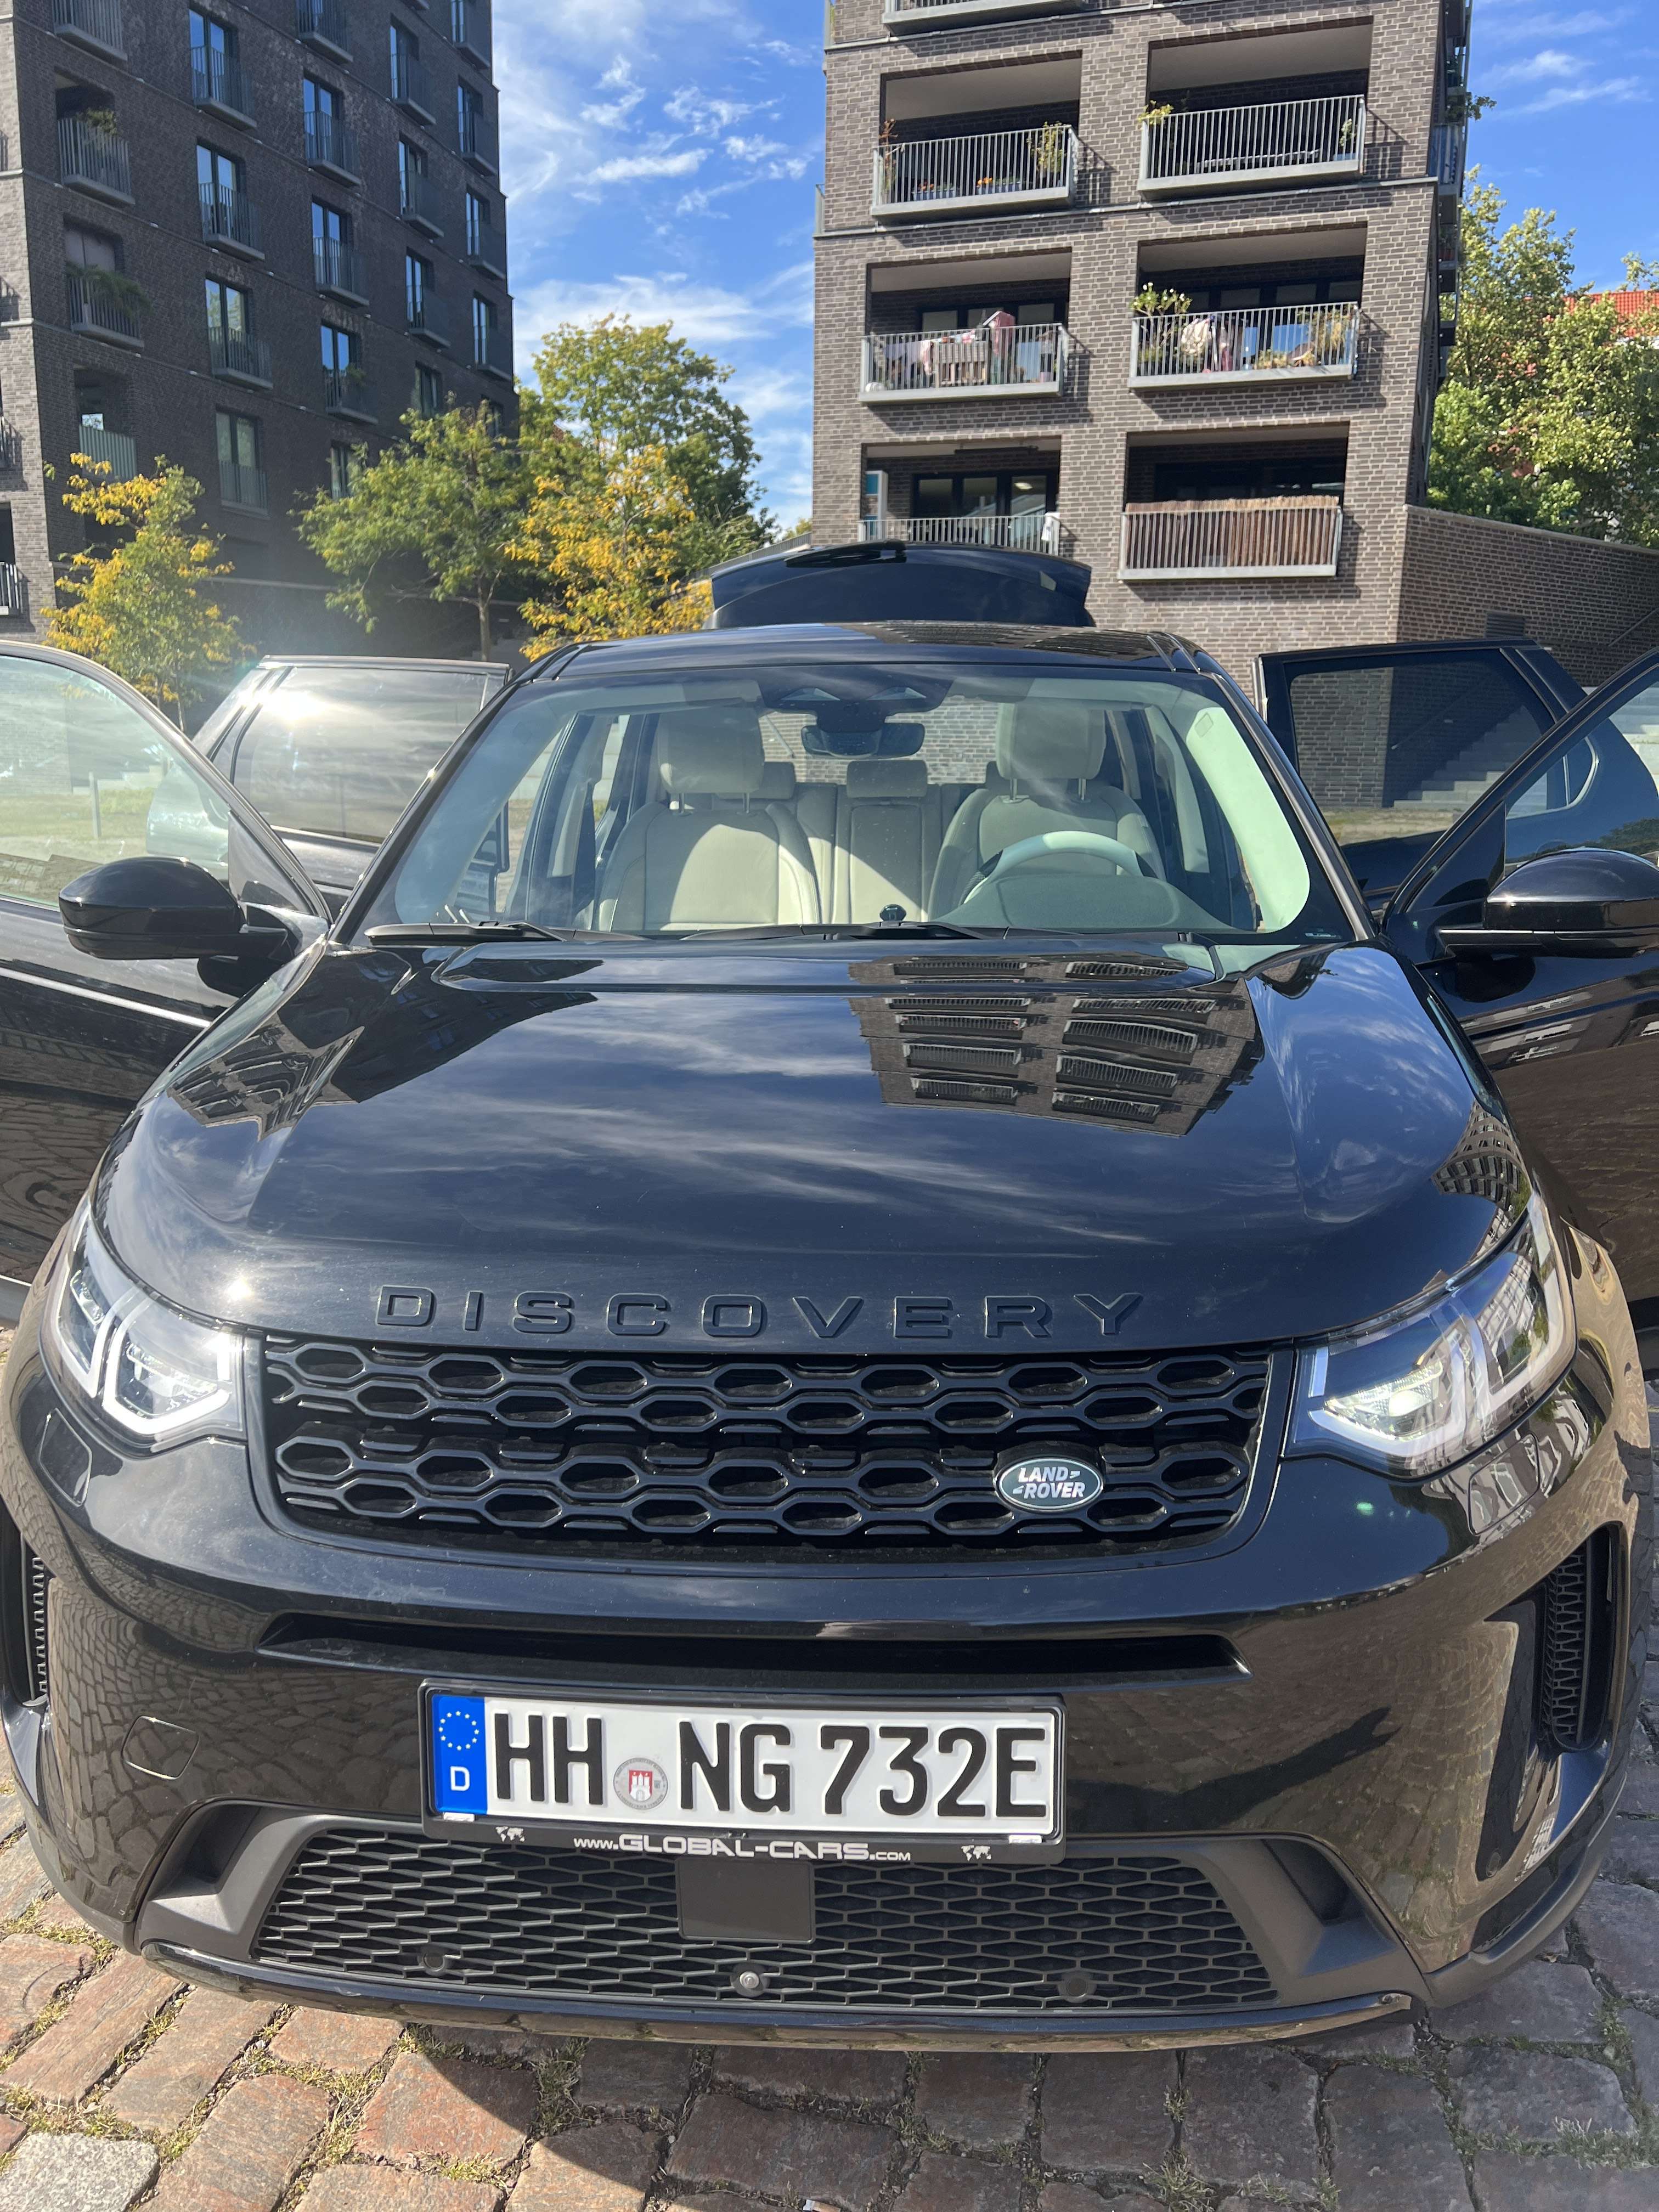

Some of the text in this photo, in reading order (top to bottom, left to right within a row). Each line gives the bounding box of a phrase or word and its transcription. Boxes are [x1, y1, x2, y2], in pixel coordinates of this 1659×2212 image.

[376, 1285, 1143, 1338] DISCOVERY
[1018, 1466, 1069, 1482] LAND
[1023, 1482, 1086, 1499] ROVER
[450, 1765, 470, 1791] D
[494, 1713, 1046, 1817] HH NG 732E
